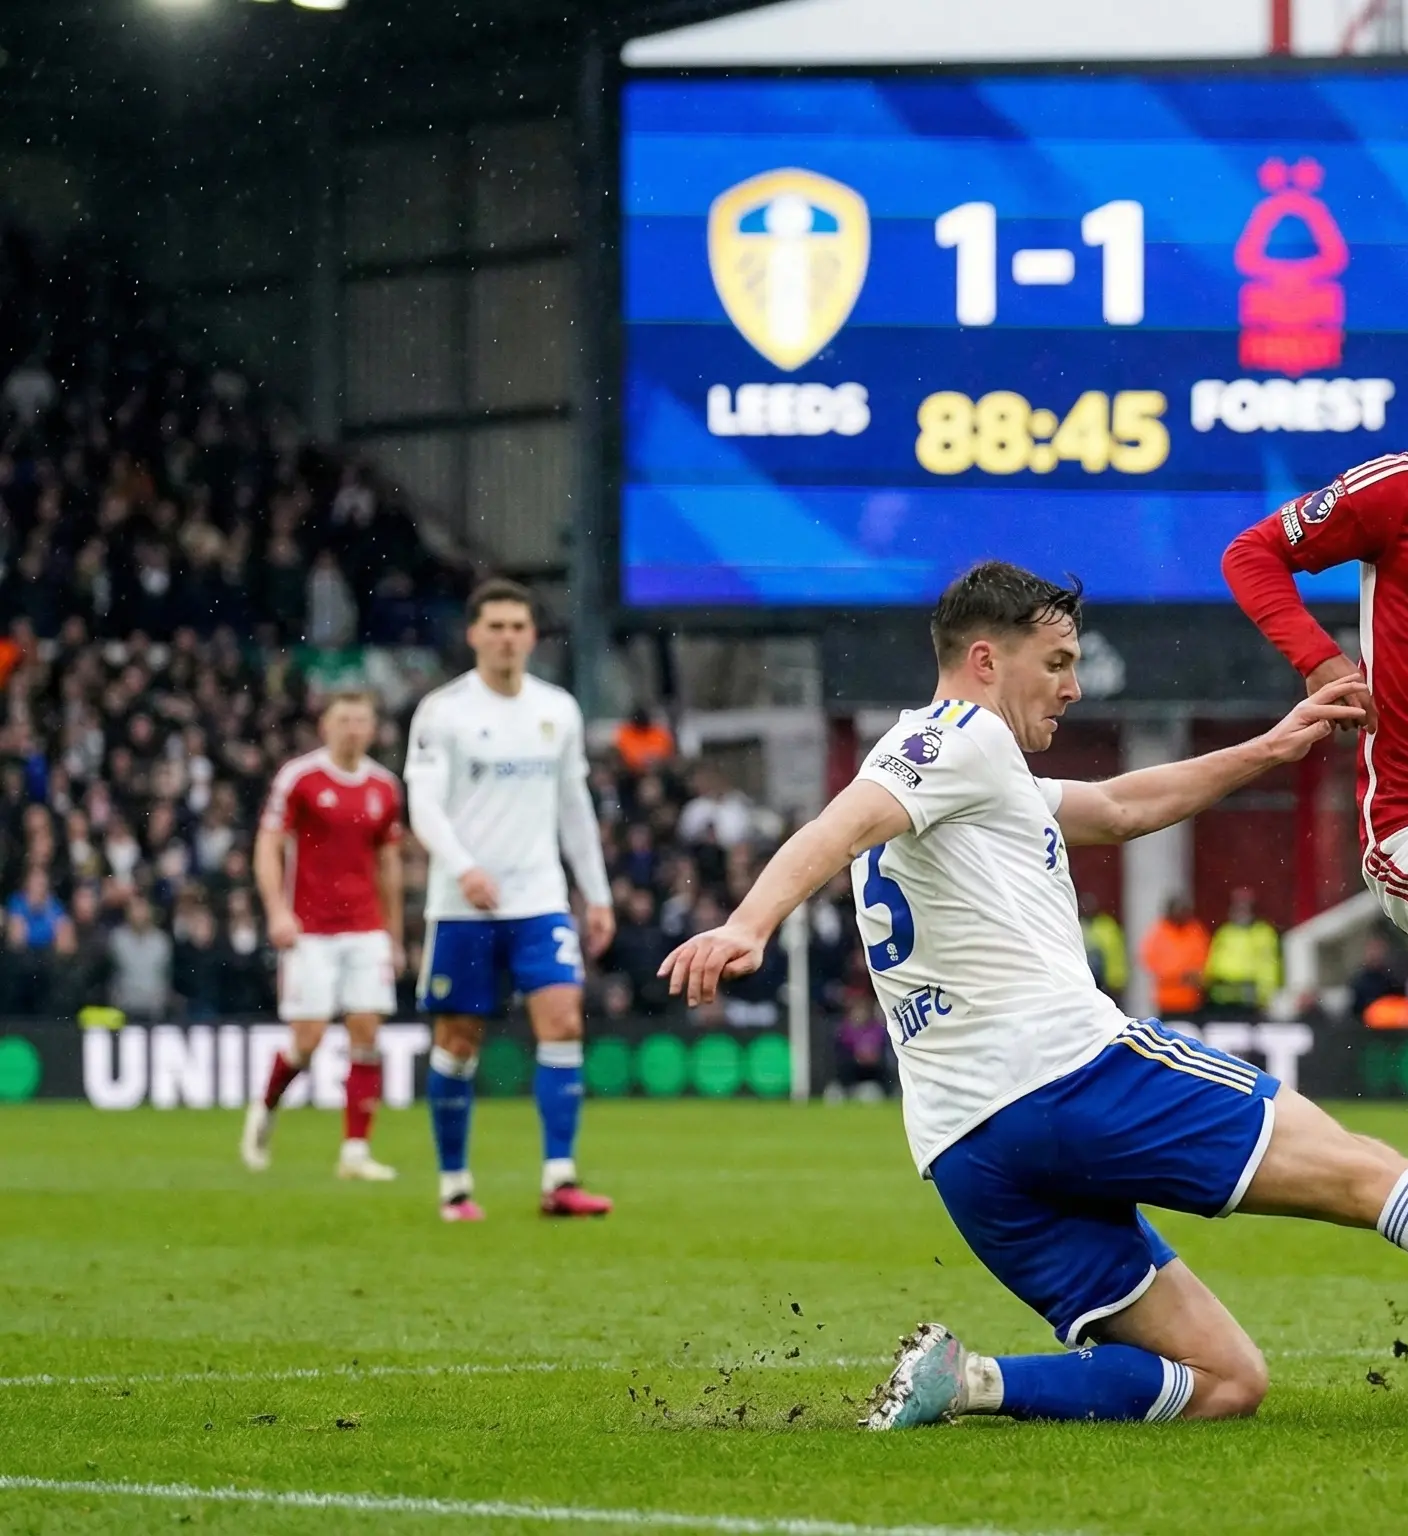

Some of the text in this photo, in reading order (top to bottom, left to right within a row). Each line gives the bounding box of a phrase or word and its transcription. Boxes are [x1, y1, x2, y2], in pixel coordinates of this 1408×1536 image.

[935, 199, 1144, 327] 1-1
[706, 381, 871, 437] LEEDS
[915, 390, 1170, 475] 88:45
[1190, 377, 1396, 433] FOREST
